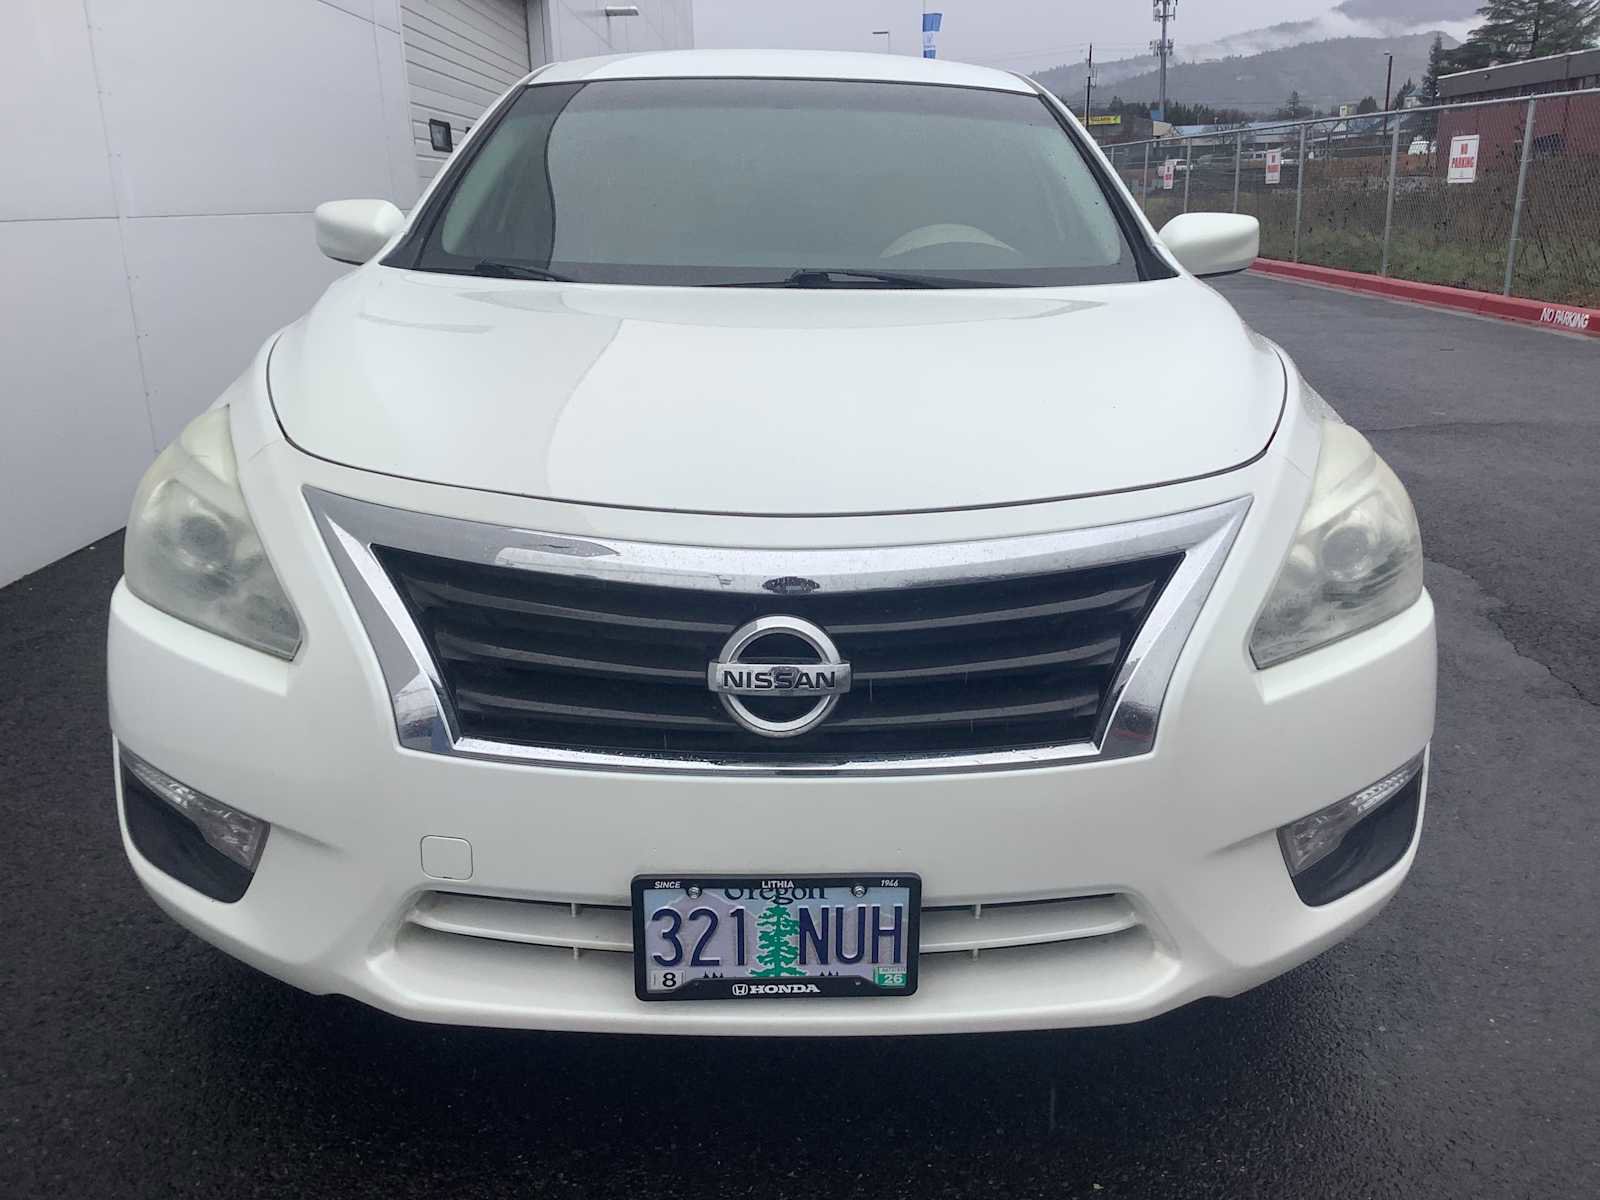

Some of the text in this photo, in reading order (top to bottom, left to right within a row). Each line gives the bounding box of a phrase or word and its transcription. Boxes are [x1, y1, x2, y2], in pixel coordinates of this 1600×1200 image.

[1540, 307, 1590, 329] NO PARKING
[723, 670, 836, 689] NISSAN
[654, 881, 681, 889] SINCE
[761, 880, 795, 889] LITHIA
[880, 879, 899, 887] 1946
[651, 905, 902, 967] 321 NUH
[662, 972, 677, 988] 8
[884, 974, 904, 985] 26
[749, 983, 821, 995] HONDA
